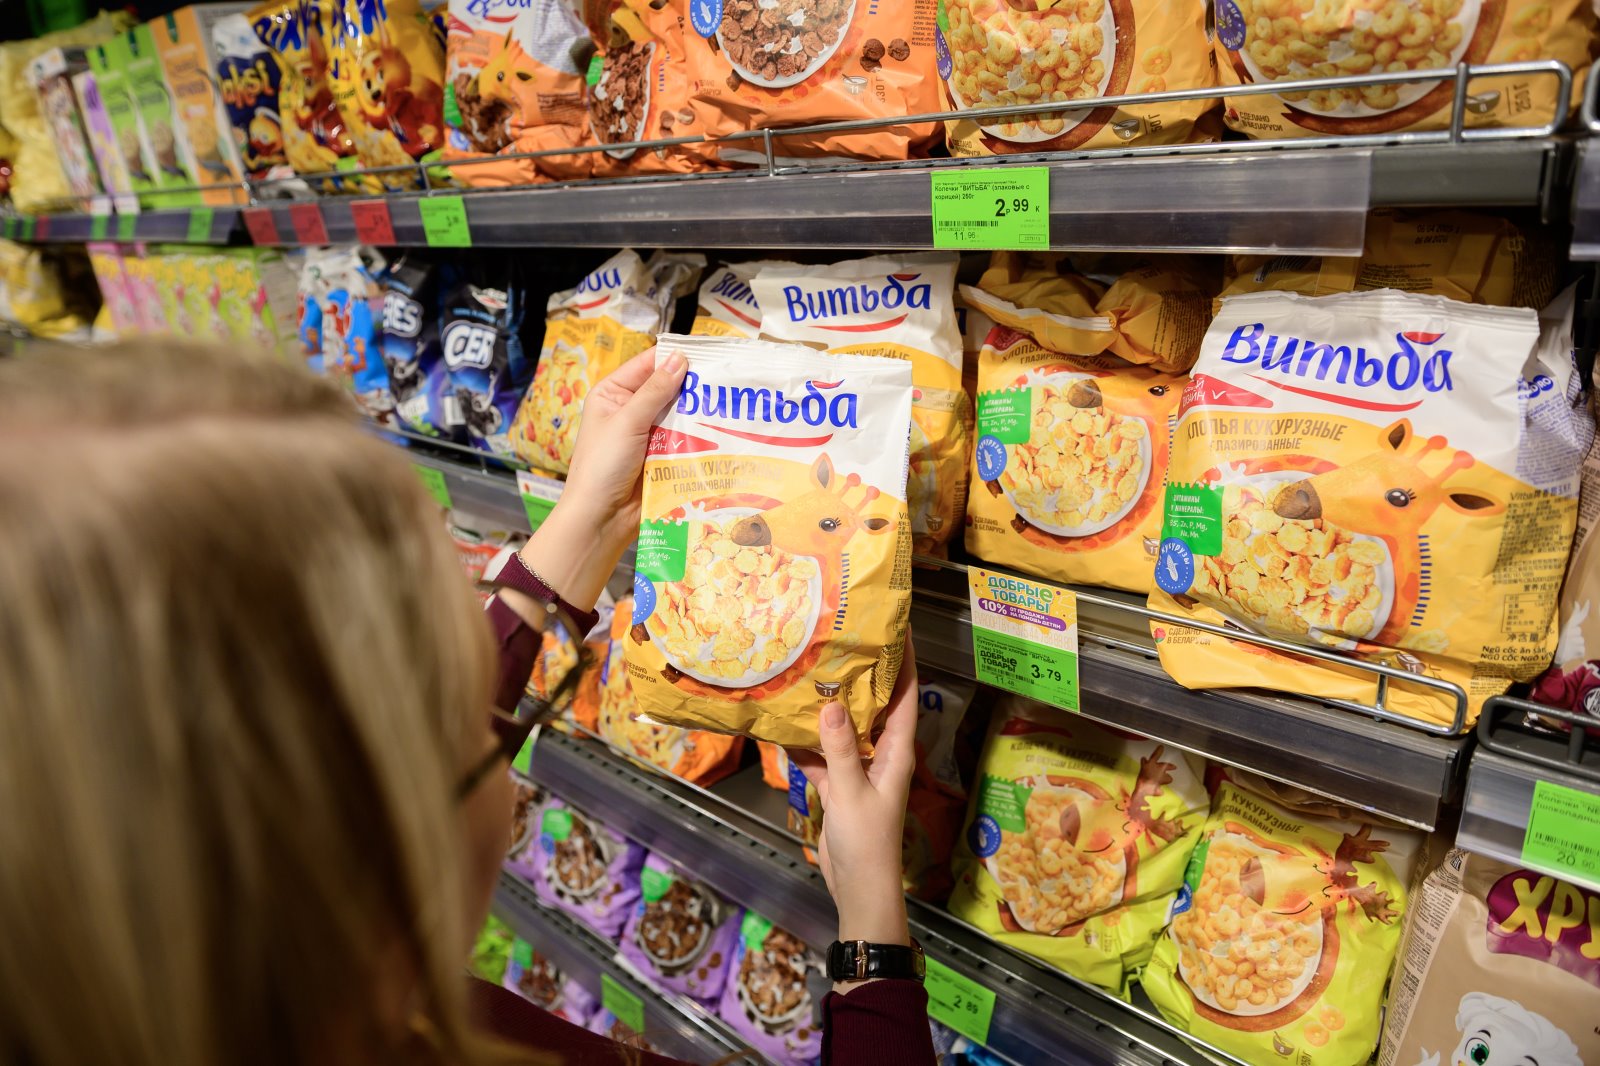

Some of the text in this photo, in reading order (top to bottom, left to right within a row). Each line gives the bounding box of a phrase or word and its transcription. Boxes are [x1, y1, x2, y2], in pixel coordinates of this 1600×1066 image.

[1239, 111, 1271, 123] СДЕЛАНО
[783, 273, 932, 322] Витьба
[1221, 322, 1454, 393] Витьба
[676, 371, 858, 430] Витьба
[1243, 418, 1348, 442] КУКУРУЗНЫЕ
[1210, 438, 1303, 452] ГЛАЗИРОВАННЫЕ
[981, 600, 1008, 615] 10%
[1018, 608, 1045, 620] ПРОДАЖИ
[990, 589, 1050, 613] ТОВАРЫ
[1042, 620, 1062, 629] ДЕТЯМ
[983, 657, 1016, 673] ТОВАРЫ
[823, 689, 833, 697] 11
[1231, 792, 1304, 834] КУКУРУЗНЫЕ
[1242, 812, 1274, 836] БАНАНА
